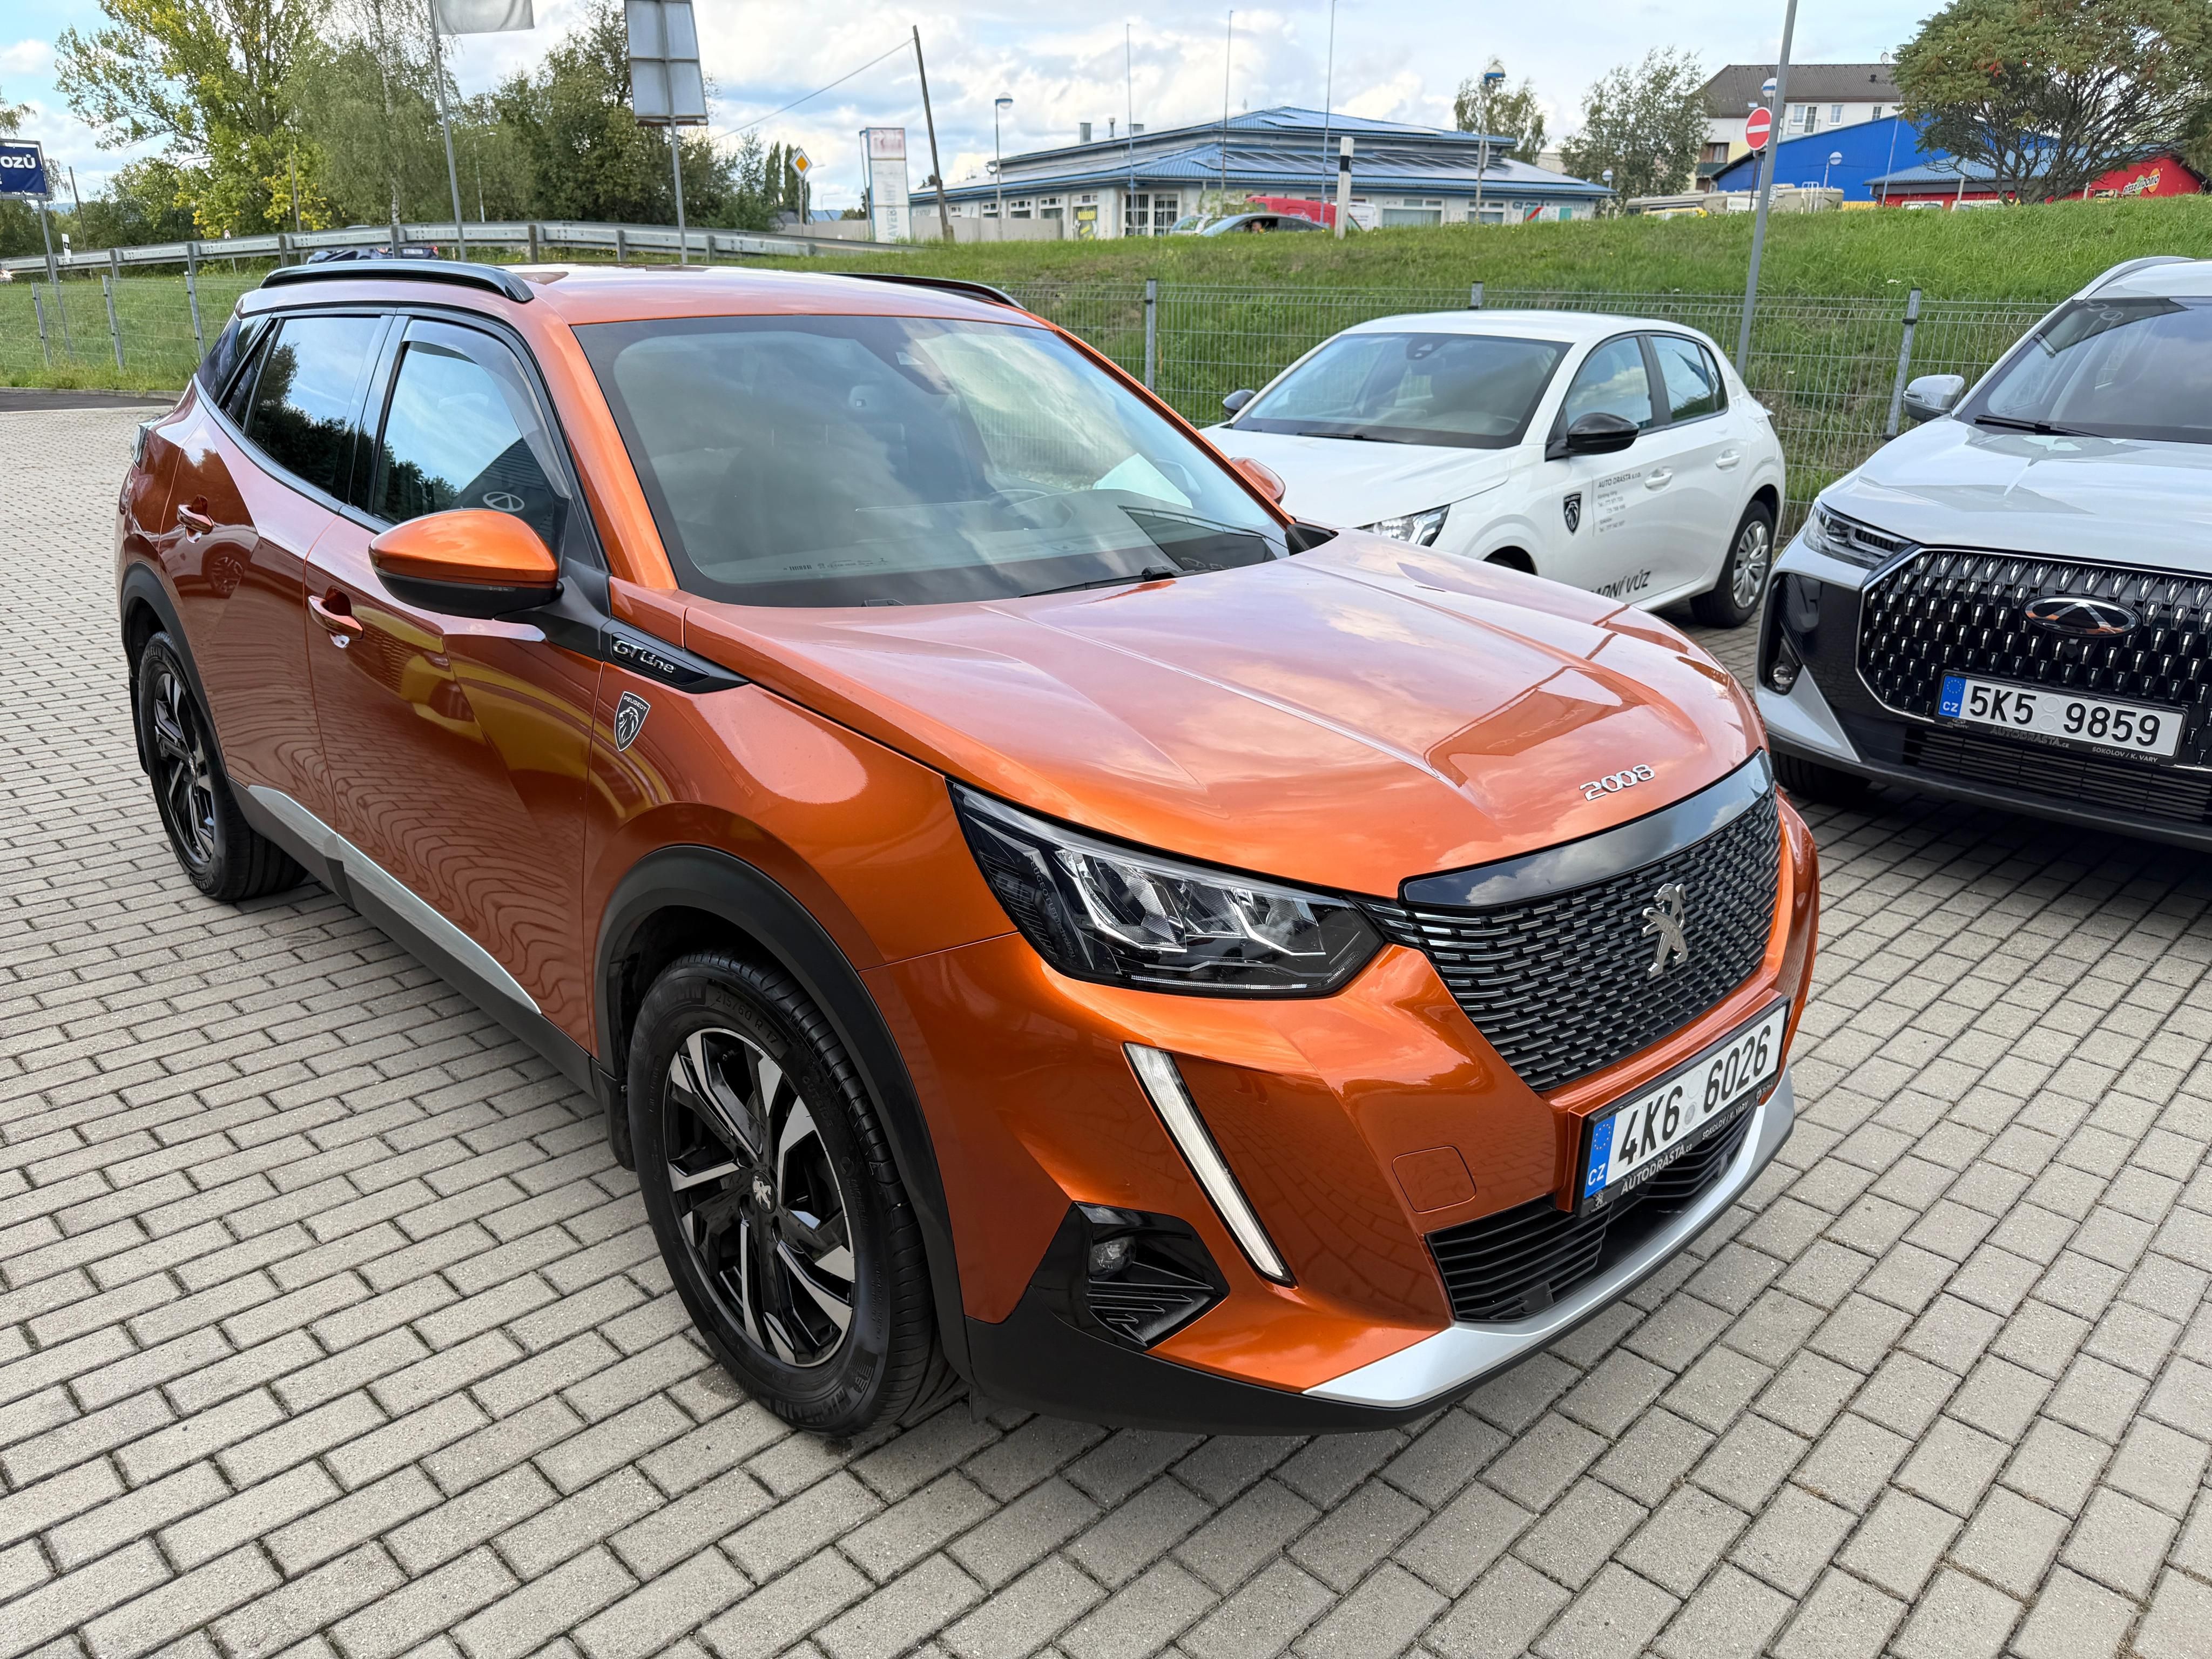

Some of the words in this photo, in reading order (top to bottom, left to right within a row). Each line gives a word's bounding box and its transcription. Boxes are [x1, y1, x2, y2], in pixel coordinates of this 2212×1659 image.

[1598, 478, 1612, 488] AUTO
[613, 640, 644, 658] GT
[640, 651, 674, 673] Line
[623, 696, 647, 711] PEUGEOT
[1943, 701, 1959, 713] CZ
[1969, 685, 2037, 725] 5K5
[2063, 703, 2161, 746] 9859
[2092, 746, 2125, 757] SOKOLOV
[1579, 764, 1655, 801] 2008
[1029, 855, 1052, 905] PEUGEOT
[1055, 919, 1076, 959] Technology
[716, 992, 751, 1021] 215/60
[755, 1019, 763, 1030] R
[767, 1030, 778, 1043] 17
[1618, 1085, 1683, 1165] 4K6
[1703, 1025, 1771, 1114] 6026
[1702, 1116, 1726, 1139] SOKOLOV
[1736, 1101, 1749, 1114] VARY
[1588, 1163, 1606, 1186] CZ
